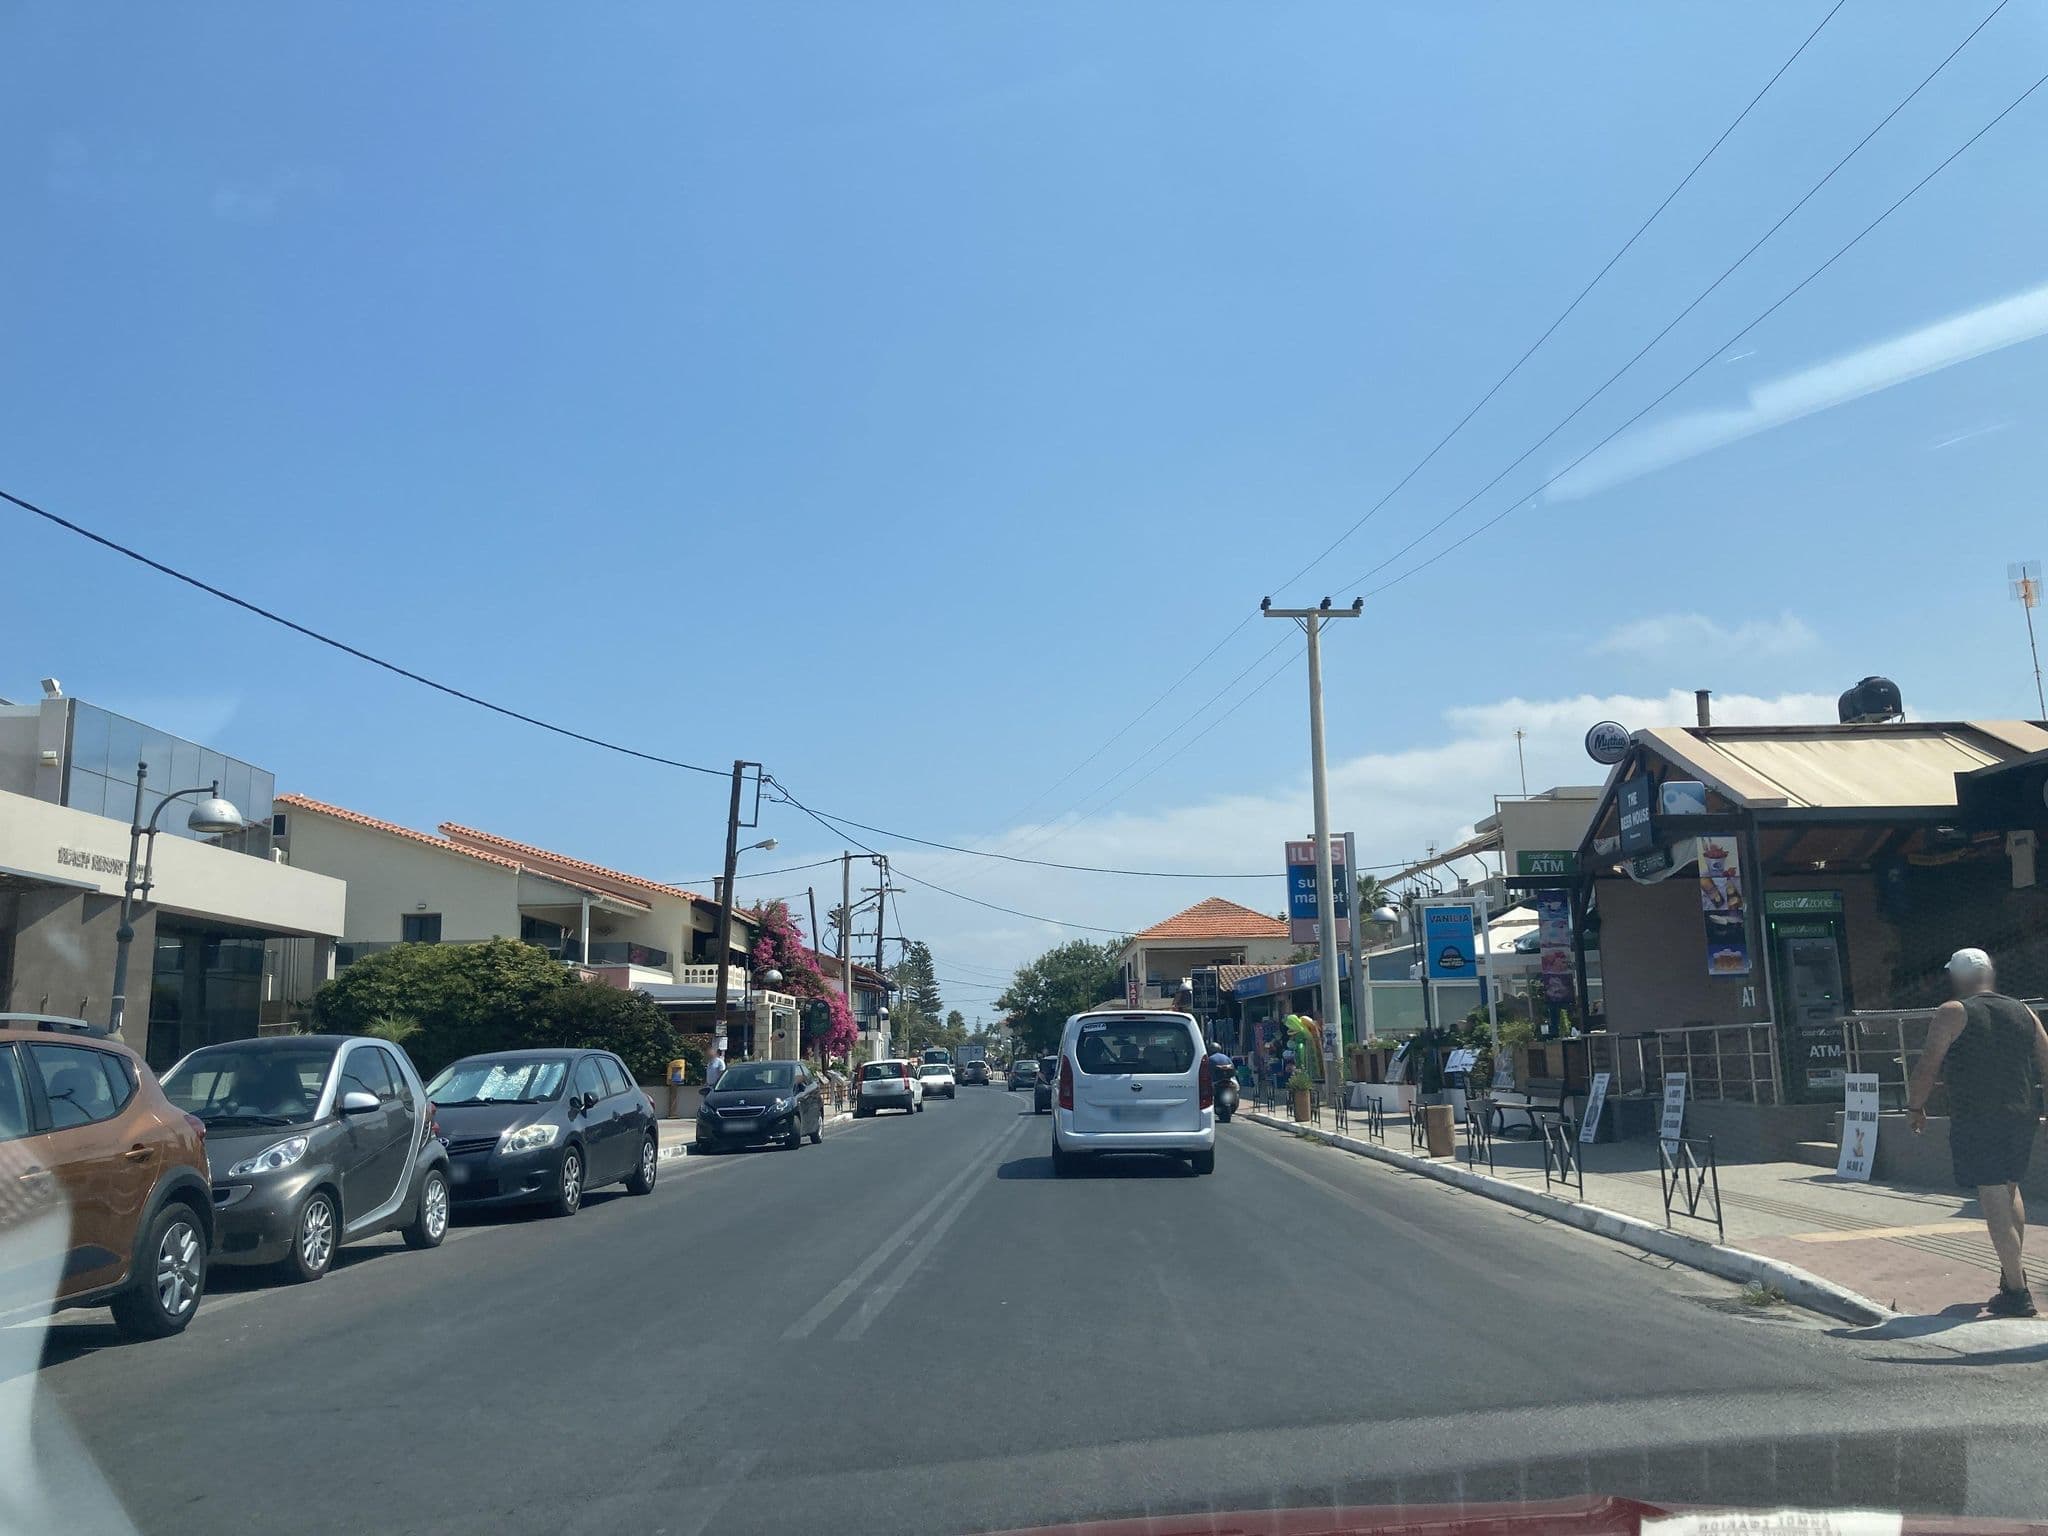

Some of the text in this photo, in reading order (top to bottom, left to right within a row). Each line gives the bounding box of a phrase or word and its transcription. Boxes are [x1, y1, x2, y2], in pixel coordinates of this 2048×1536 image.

[1627, 791, 1638, 808] THE
[1632, 807, 1650, 826] HOUSE
[1531, 860, 1564, 872] ATM
[1298, 878, 1339, 888] sur
[1295, 891, 1344, 903] maet
[1809, 1045, 1841, 1057] ATM
